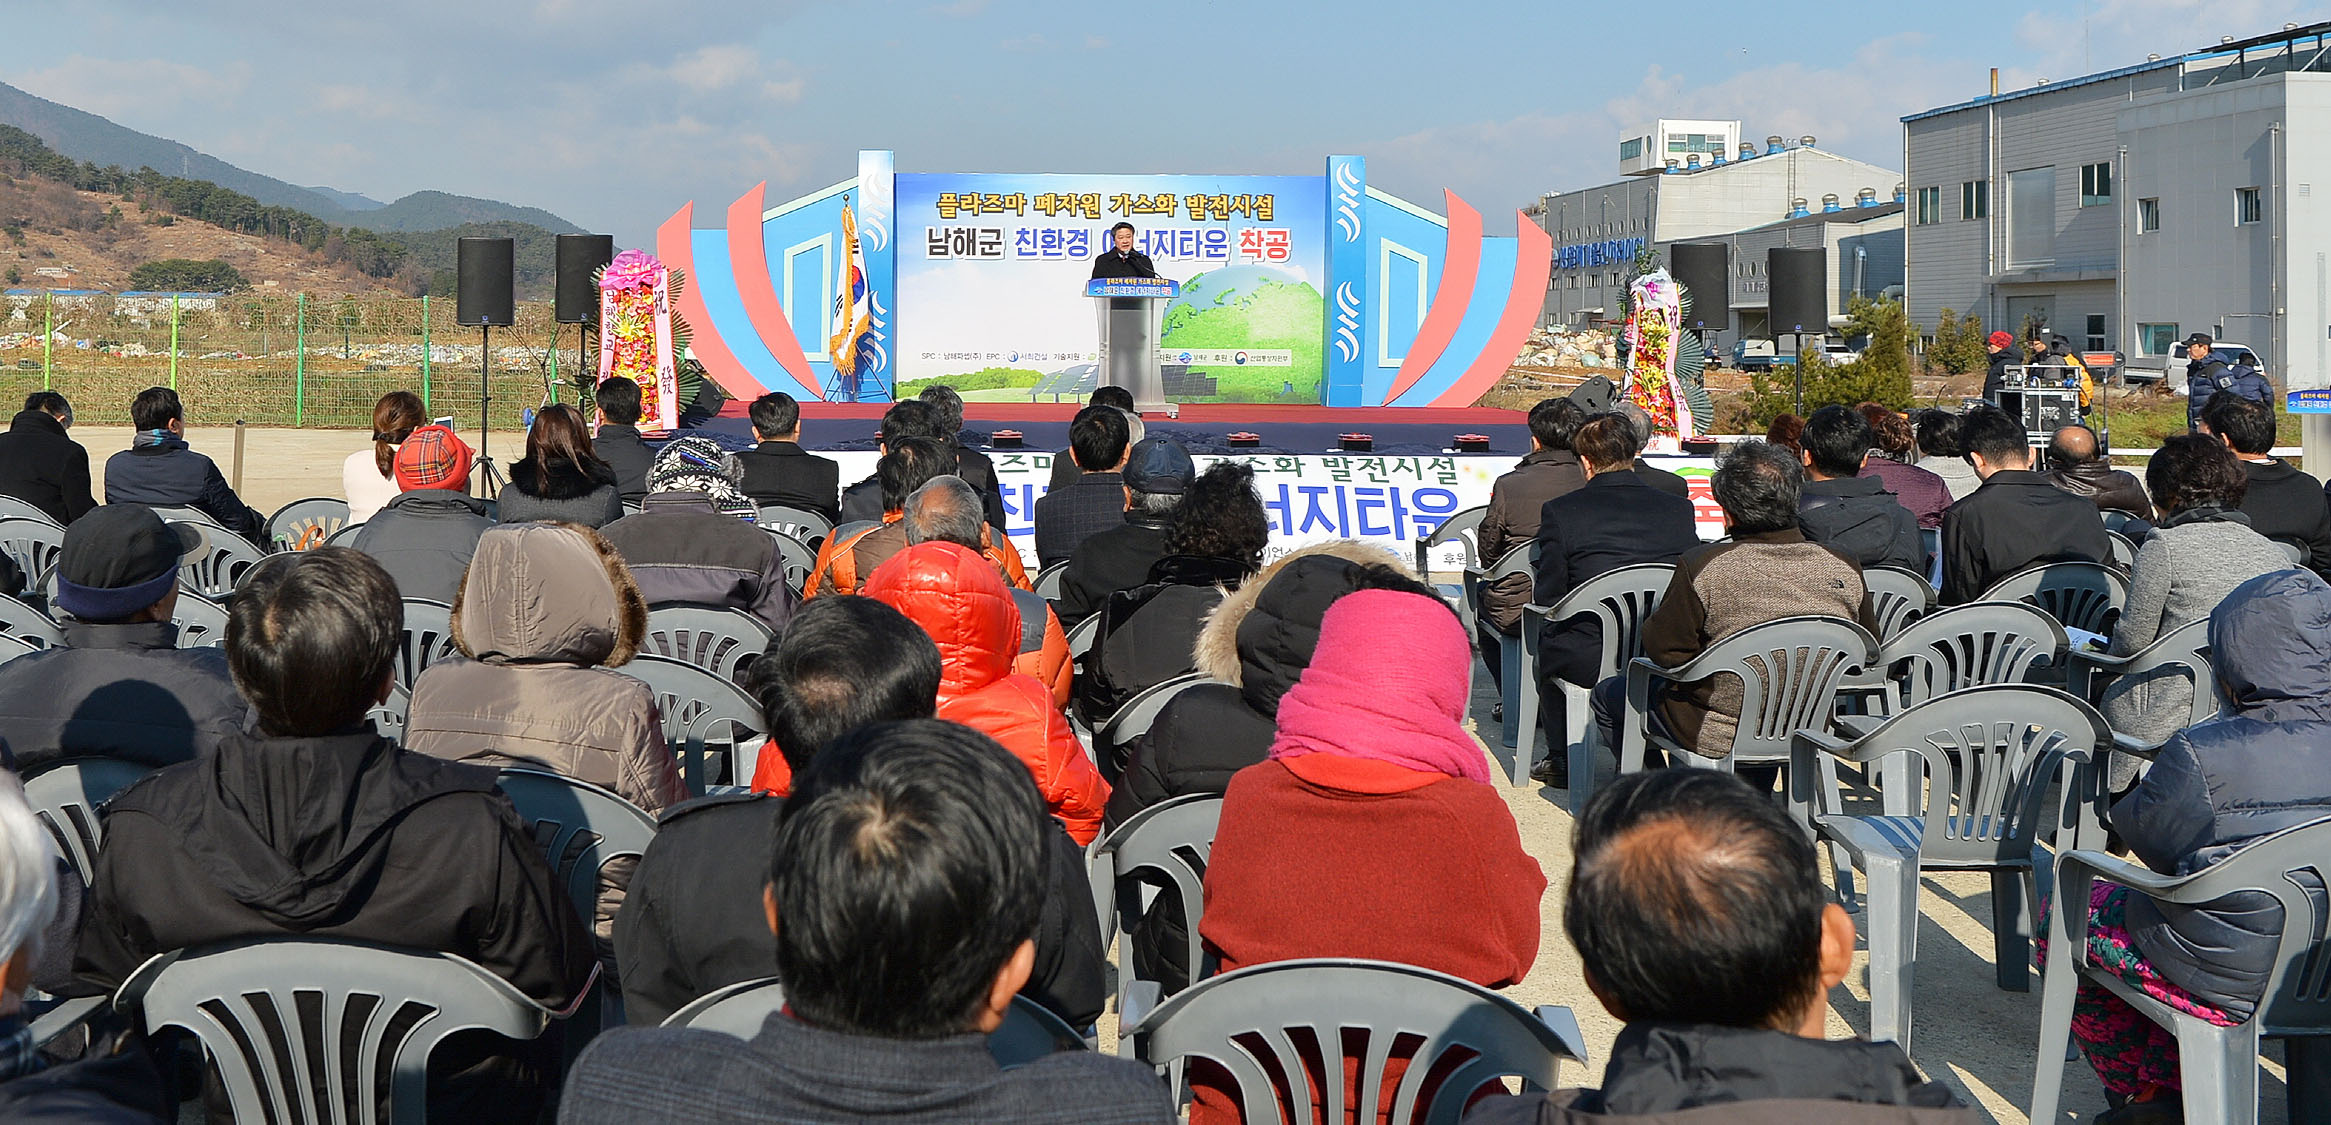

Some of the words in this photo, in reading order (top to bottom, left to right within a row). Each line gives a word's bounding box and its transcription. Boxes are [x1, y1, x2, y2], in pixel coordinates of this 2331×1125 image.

[937, 192, 1027, 219] 플라즈마
[1034, 192, 1101, 219] 폐자원
[1108, 192, 1178, 217] 가스화
[1184, 193, 1274, 221] 발전시설
[928, 227, 1002, 257] 남해군
[1015, 227, 1089, 257] 친환경
[1102, 229, 1227, 258] 너지타운
[1240, 227, 1289, 259] 착공
[921, 352, 935, 360] SPC
[1053, 352, 1080, 361] 기술지원
[1321, 456, 1459, 485] 발전시설
